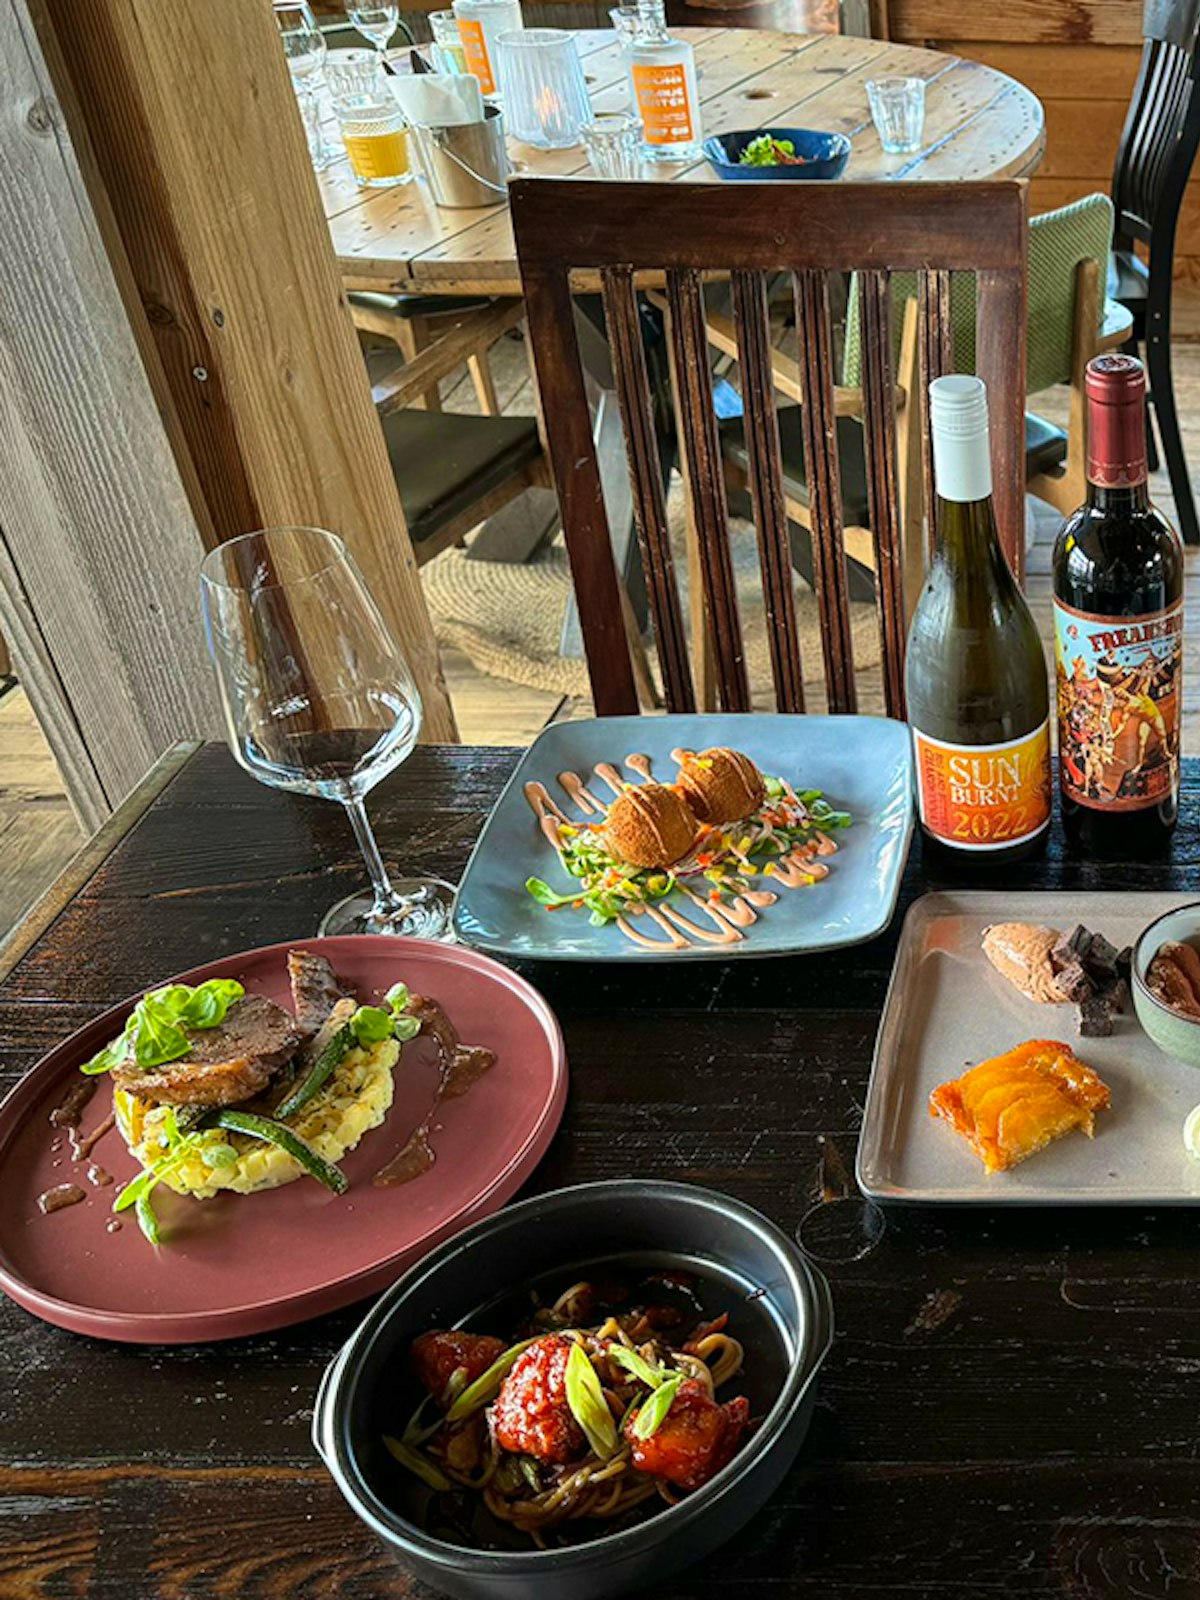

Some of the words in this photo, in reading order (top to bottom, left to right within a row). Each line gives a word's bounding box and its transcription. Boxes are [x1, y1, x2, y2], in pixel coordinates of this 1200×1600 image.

[949, 753, 1022, 789] SUN
[951, 784, 1020, 806] BURNT
[952, 806, 1028, 838] 2022
